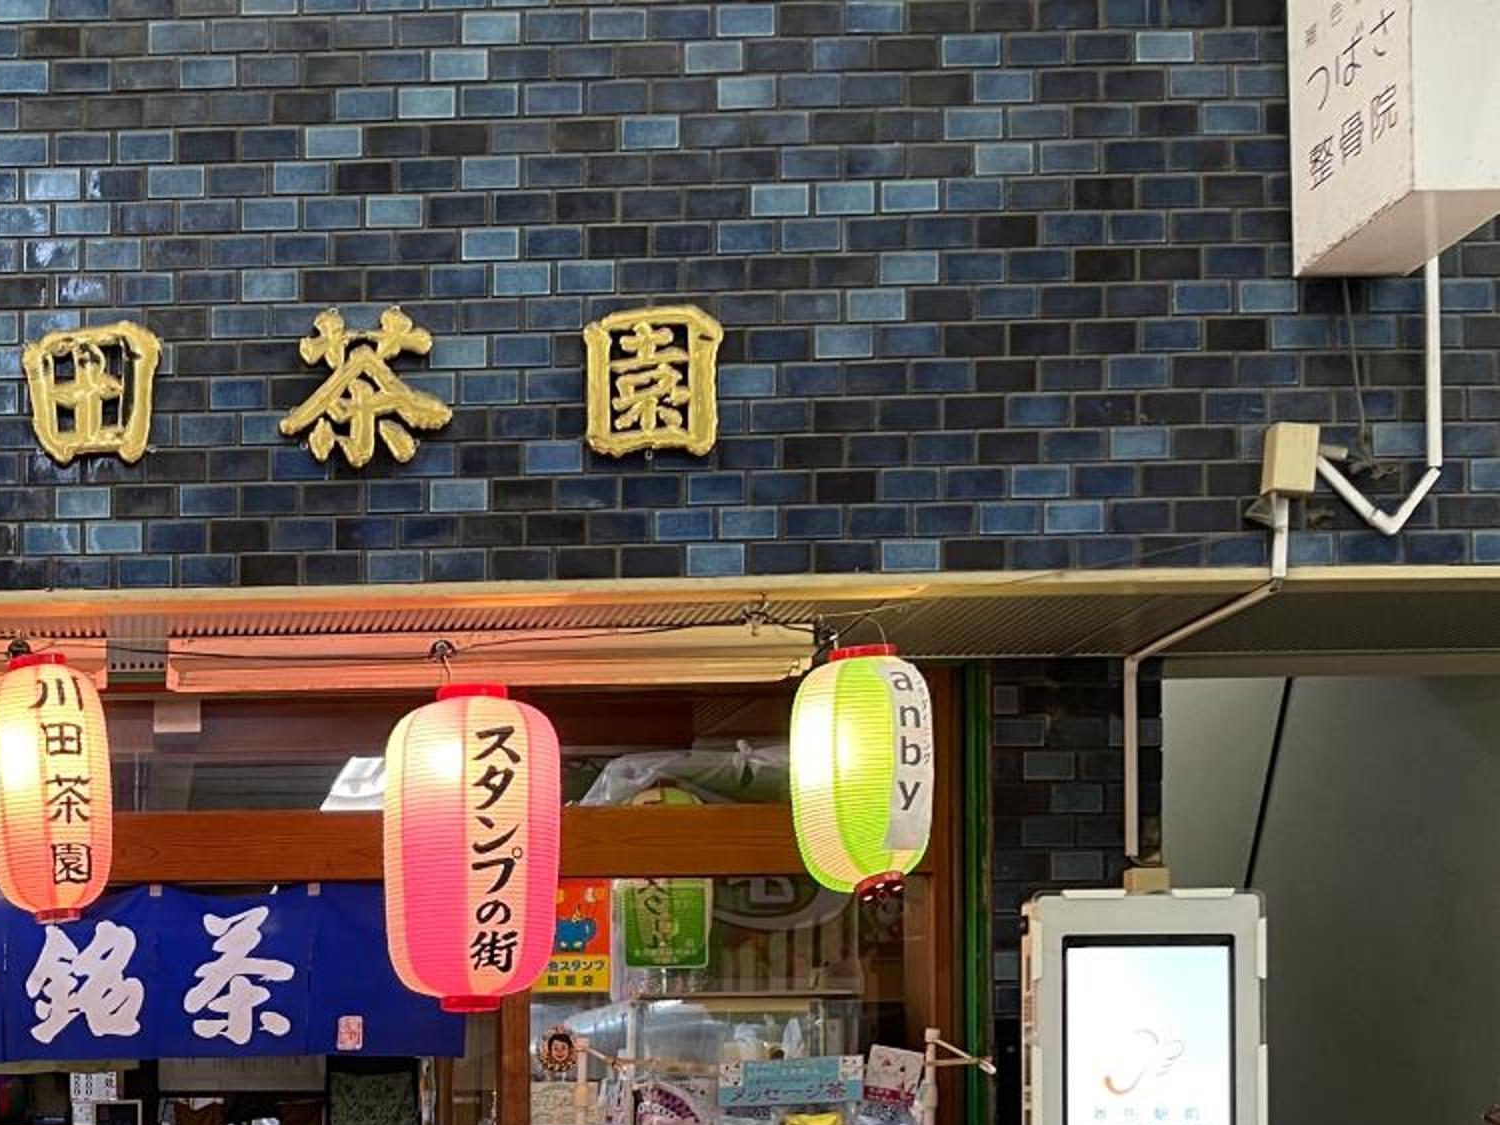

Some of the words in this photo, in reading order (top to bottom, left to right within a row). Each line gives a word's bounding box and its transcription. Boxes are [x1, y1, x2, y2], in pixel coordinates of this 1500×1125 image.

[29, 676, 92, 886] 川田茶園
[890, 671, 922, 811] anby
[470, 725, 525, 974] スタンプの街
